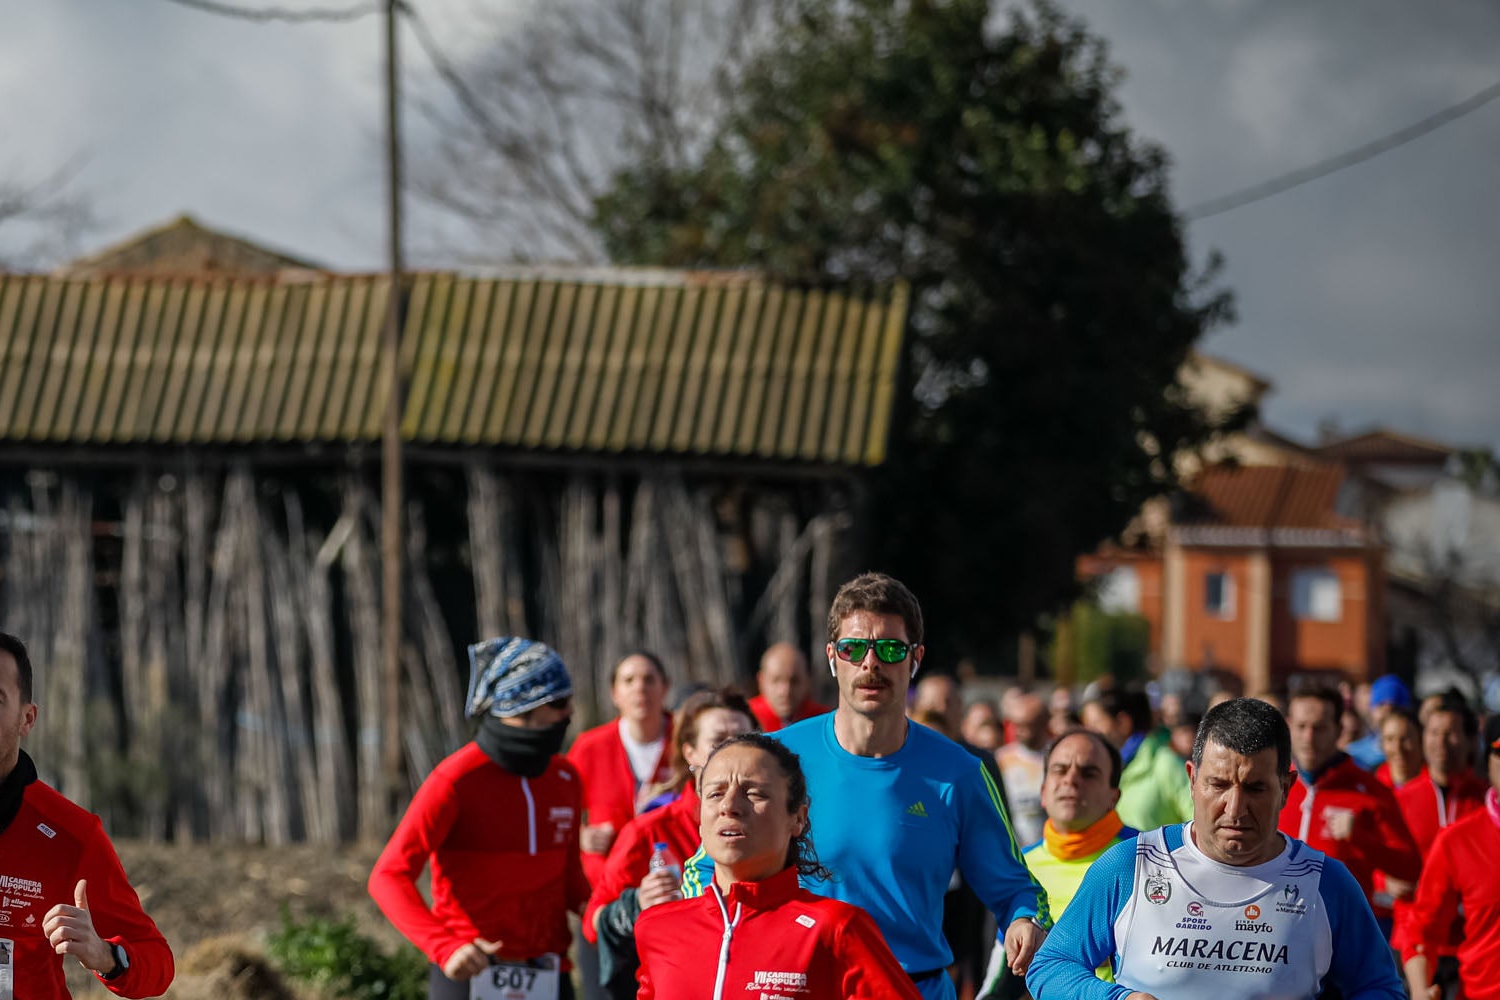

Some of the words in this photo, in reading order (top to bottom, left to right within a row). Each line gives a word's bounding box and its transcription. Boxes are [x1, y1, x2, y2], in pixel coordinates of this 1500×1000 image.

[8, 882, 42, 894] POPULAR
[9, 876, 42, 888] CARRERA
[1175, 922, 1212, 931] GARRIDO
[1182, 917, 1207, 925] SPORT
[1235, 922, 1273, 934] mayfo
[1151, 936, 1289, 965] MARACENA
[1166, 960, 1194, 969] CLUB
[1197, 962, 1212, 970] DE
[1213, 964, 1273, 974] ATLETISMO
[492, 966, 537, 992] 607
[766, 977, 807, 986] POPULAR
[767, 971, 807, 980] CARRERA
